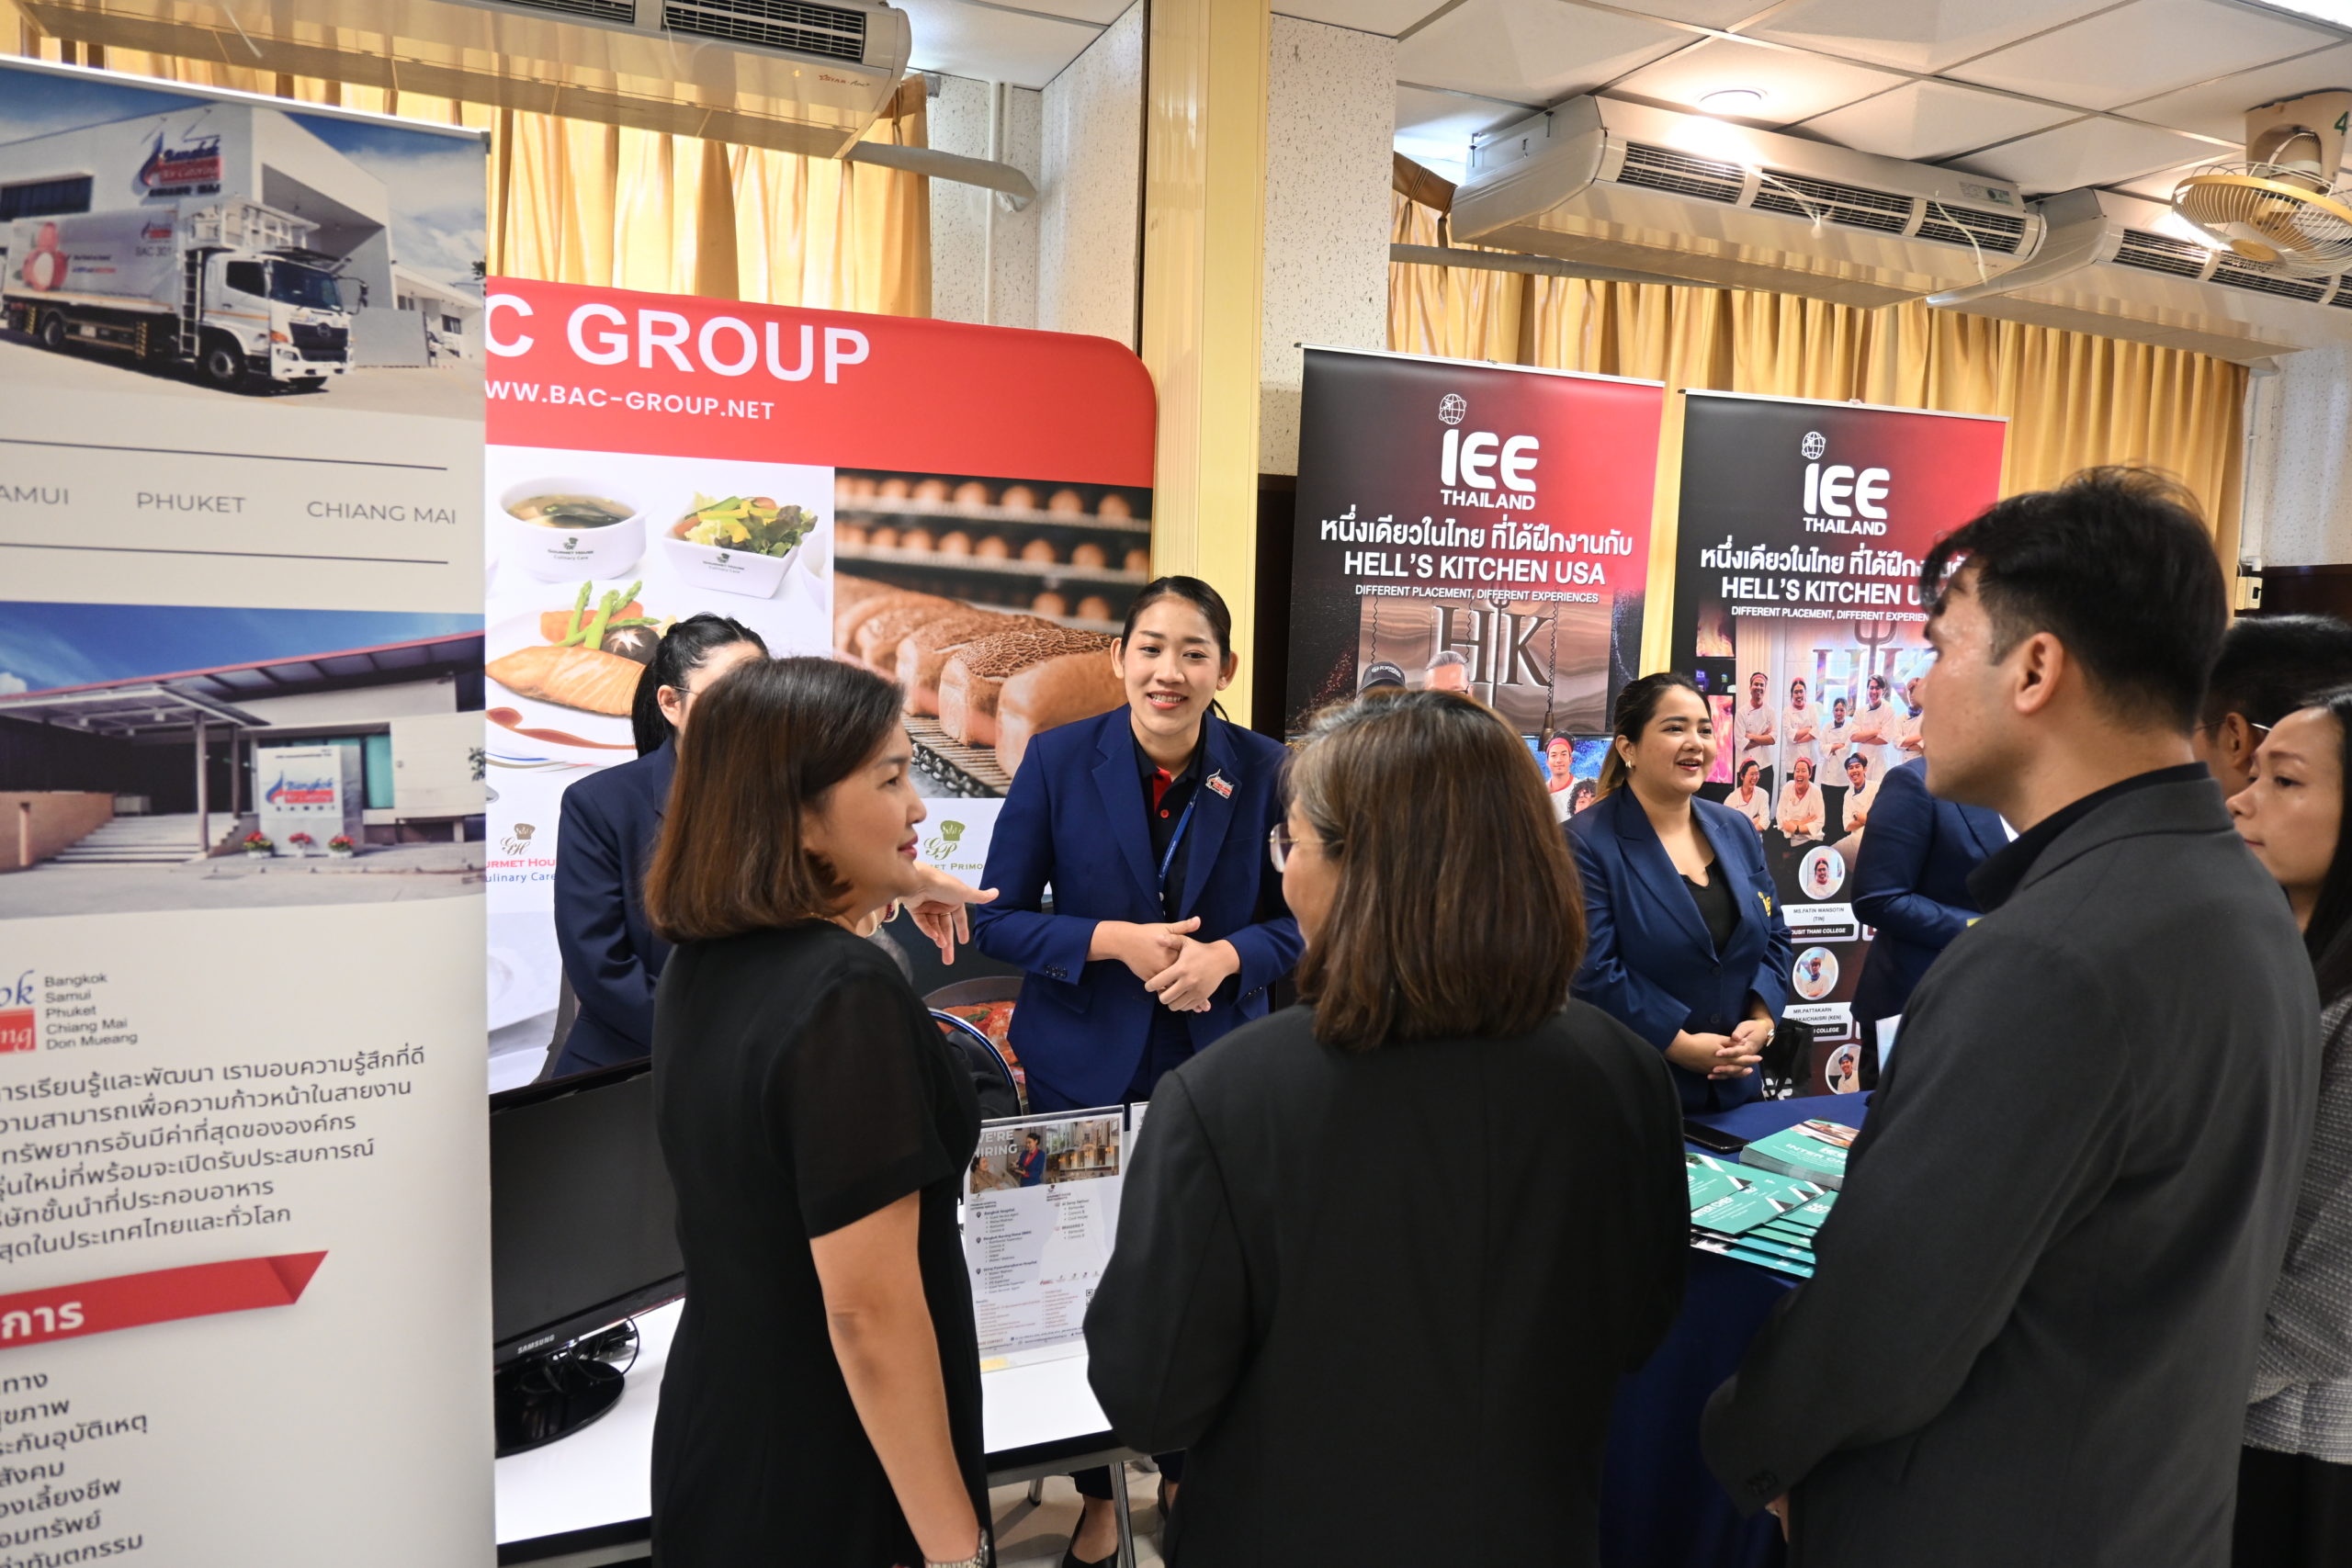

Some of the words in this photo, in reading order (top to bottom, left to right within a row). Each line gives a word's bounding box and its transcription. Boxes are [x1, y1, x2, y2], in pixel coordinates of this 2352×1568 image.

[2334, 110, 2348, 137] 4
[566, 302, 871, 385] GROUP
[136, 491, 247, 514] PHUKET
[306, 500, 406, 523] CHIANG
[413, 506, 457, 525] MAI
[1440, 489, 1536, 511] THAILAND
[1803, 516, 1887, 536] THAILAND
[1344, 551, 1433, 579] HELL'S
[1439, 556, 1549, 584] KITCHEN
[1555, 562, 1606, 586] USA
[1355, 584, 1411, 597] DIFFERENT
[1412, 586, 1476, 600] PLACEMENT,
[1476, 589, 1532, 602] DIFFERENT
[1532, 591, 1599, 604] EXPERIENCES
[1721, 576, 1801, 600] HELL'S
[1804, 581, 1902, 605] KITCHEN
[1731, 605, 1781, 617] DIFFERENT
[1781, 606, 1836, 620] PLACEMENT,
[1837, 609, 1884, 621] DIFFERENT
[1885, 611, 1929, 622] EXPERIEN
[527, 858, 557, 867] HOU
[950, 863, 984, 871] PRIMO
[531, 872, 557, 881] Care
[44, 973, 108, 988] Bangkok
[45, 989, 92, 1004] Samui
[45, 1005, 96, 1019] Phuket
[46, 1020, 97, 1035] Chiang
[102, 1018, 128, 1030] Mai
[46, 1037, 76, 1051] Don
[81, 1032, 138, 1047] Mueang
[517, 1334, 556, 1355] SAMSUNG
